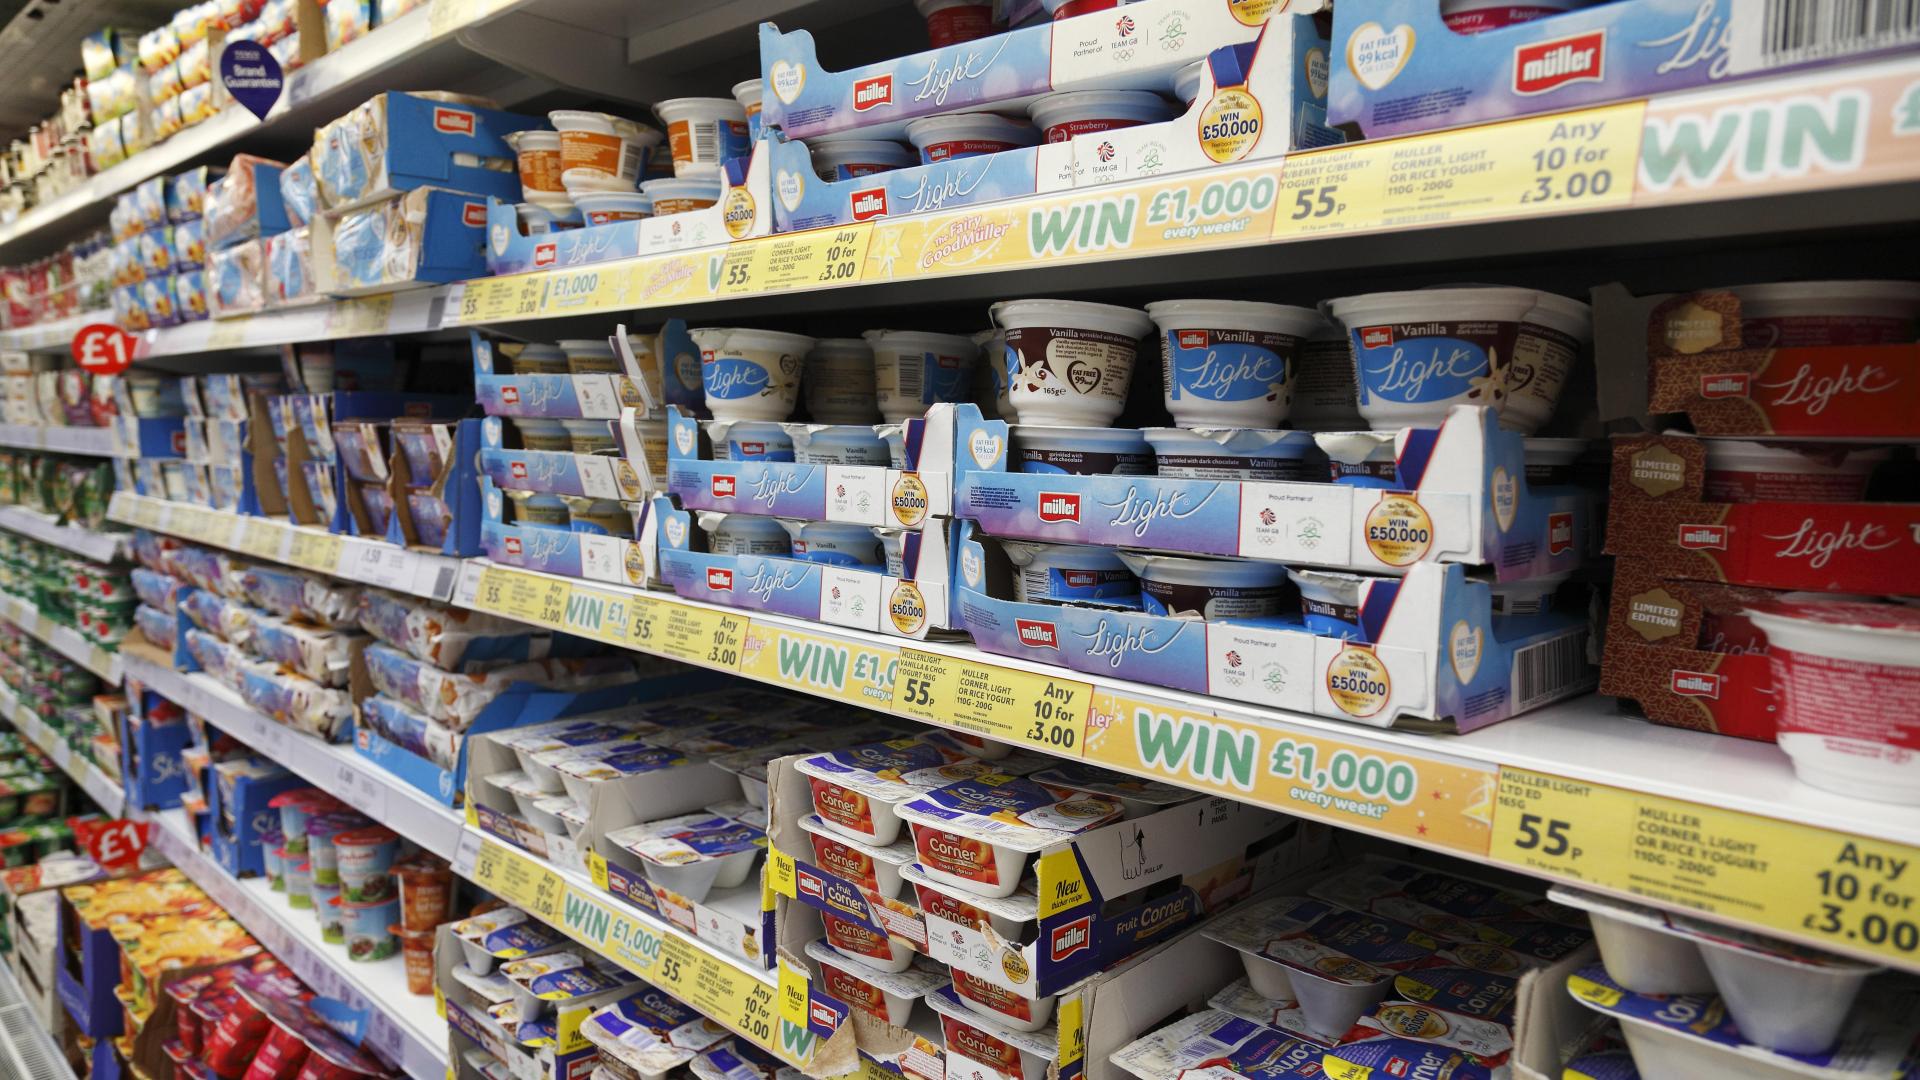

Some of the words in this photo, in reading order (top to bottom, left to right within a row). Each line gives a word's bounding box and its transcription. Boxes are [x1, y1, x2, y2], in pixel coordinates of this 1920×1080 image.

[1079, 39, 1098, 48] Proud
[1111, 39, 1128, 49] TEAM
[1360, 39, 1375, 50] FAT
[1377, 35, 1397, 48] FREE
[1638, 0, 1732, 79] Lig
[1073, 47, 1093, 57] Partner
[233, 64, 266, 77] Brand
[908, 33, 1012, 106] Light
[1522, 45, 1595, 82] müller
[224, 75, 281, 89] Guarantee
[857, 83, 889, 102] müller
[1070, 121, 1108, 131] Strawberry
[1220, 112, 1240, 122] WIN
[1203, 118, 1258, 140] £50,000
[1549, 121, 1606, 142] Any
[963, 141, 1001, 152] Strawberry
[1642, 99, 1860, 185] WIN
[1284, 152, 1354, 169] MULLERLIGHT
[1391, 157, 1444, 172] CORNER,
[1448, 150, 1488, 164] LIGHT
[1393, 145, 1443, 159] MULLER
[1532, 147, 1566, 172] 10
[1574, 147, 1609, 164] for
[1409, 168, 1440, 181] RICE
[1441, 161, 1496, 177] YOGURT
[900, 154, 995, 212] Light
[1280, 177, 1321, 190] YOGURT
[1422, 179, 1454, 193] 200G
[1521, 170, 1612, 204] £3.00
[855, 196, 884, 214] müller
[1031, 198, 1136, 253] WIN
[1149, 176, 1275, 224] £1,000
[950, 214, 983, 238] Fairy
[1163, 223, 1201, 239] every
[835, 231, 858, 244] Any
[826, 247, 840, 262] 10
[842, 248, 857, 258] for
[819, 262, 856, 281] £3.00
[553, 273, 598, 297] £1,000
[1050, 329, 1079, 338] Vanilla
[1216, 331, 1255, 343] Vanilla
[1364, 332, 1390, 345] müller
[1401, 323, 1447, 337] Vanilla
[80, 332, 127, 365] £1
[706, 365, 770, 397] Light
[1180, 350, 1284, 399] Light
[1366, 347, 1488, 401] Light
[1706, 378, 1744, 393] müller
[1757, 364, 1899, 415] Light
[1250, 459, 1278, 468] Vanilla
[1340, 462, 1370, 475] Vanilla
[1635, 459, 1681, 473] LIMITED
[1634, 469, 1681, 481] EDITION
[713, 481, 735, 492] müller
[750, 465, 815, 508] Light
[894, 497, 925, 509] £50,000
[1042, 496, 1077, 516] müller
[1099, 482, 1218, 537] Light
[1389, 519, 1408, 527] WIN
[1370, 526, 1428, 543] £50,000
[1684, 531, 1721, 543] müller
[1761, 518, 1900, 568] Light
[709, 575, 731, 586] müller
[742, 557, 812, 602] Light
[1069, 575, 1094, 586] müller
[1208, 587, 1240, 597] Vanilla
[892, 606, 923, 618] £50,000
[1309, 600, 1337, 616] Vanilla
[1632, 602, 1680, 617] LIMITED
[720, 616, 738, 632] Any
[1631, 612, 1678, 627] EDITION
[714, 631, 724, 645] 10
[726, 635, 737, 646] for
[1021, 625, 1053, 643] müller
[1072, 620, 1187, 667] Light
[708, 647, 736, 666] £3.00
[779, 638, 847, 688] WIN
[901, 651, 942, 666] MULLERLIGHT
[899, 668, 922, 678] YOGURT
[900, 659, 924, 671] VANILLA
[929, 666, 947, 675] CHOC
[962, 668, 989, 681] MULLER
[1349, 669, 1368, 679] WIN
[960, 678, 990, 692] CORNER,
[991, 685, 1012, 696] LIGHT
[1044, 682, 1074, 704] Any
[1331, 676, 1386, 696] £50,000
[1676, 677, 1714, 691] müller
[957, 696, 972, 707] 110G
[975, 701, 993, 711] 200G
[969, 689, 986, 700] RICE
[986, 692, 1015, 706] YOGURT
[1034, 700, 1053, 718] 10
[1056, 707, 1074, 722] for
[1027, 722, 1075, 748] £3.00
[1138, 712, 1256, 787] WIN
[1271, 740, 1414, 802] £1,000
[1500, 783, 1523, 796] LTD
[1525, 788, 1542, 800] ED
[1502, 771, 1550, 789] MULLER
[1552, 781, 1592, 797] LIGHT
[821, 791, 856, 813] Corner
[1290, 787, 1332, 807] every
[1499, 796, 1526, 810] 165G
[1640, 806, 1701, 828] MULLER
[100, 825, 141, 863] £1
[1637, 821, 1706, 846] CORNER,
[1709, 835, 1758, 856] LIGHT
[824, 847, 860, 872] Corner
[929, 837, 976, 863] Corner
[1635, 835, 1658, 849] OR
[1660, 840, 1696, 859] RICE
[1700, 849, 1769, 874] YOGURT
[776, 855, 793, 873] New
[1634, 849, 1667, 867] 110G
[1677, 858, 1718, 878] 200G
[1836, 842, 1907, 880] Any
[800, 876, 822, 893] müller
[1056, 878, 1082, 898] New
[1817, 870, 1859, 901] 10
[1869, 884, 1915, 909] for
[828, 887, 864, 911] Corner
[1050, 898, 1070, 911] thicker
[1070, 893, 1085, 906] recipe
[566, 892, 611, 943] WIN
[931, 902, 974, 928] Corner
[1116, 918, 1138, 936] Fruit
[1141, 898, 1187, 927] Corner
[1802, 903, 1920, 952] £3.00
[1055, 926, 1087, 951] müller
[752, 984, 773, 1003] Any
[786, 984, 805, 1002] New
[834, 978, 871, 1002] Corner
[644, 992, 687, 1018] Corner
[745, 997, 757, 1014] 10
[758, 1005, 771, 1020] for
[813, 1008, 836, 1025] müller
[738, 1014, 770, 1041] £3.00
[957, 1031, 1002, 1057] Corner
[1263, 1043, 1323, 1079] Corner
